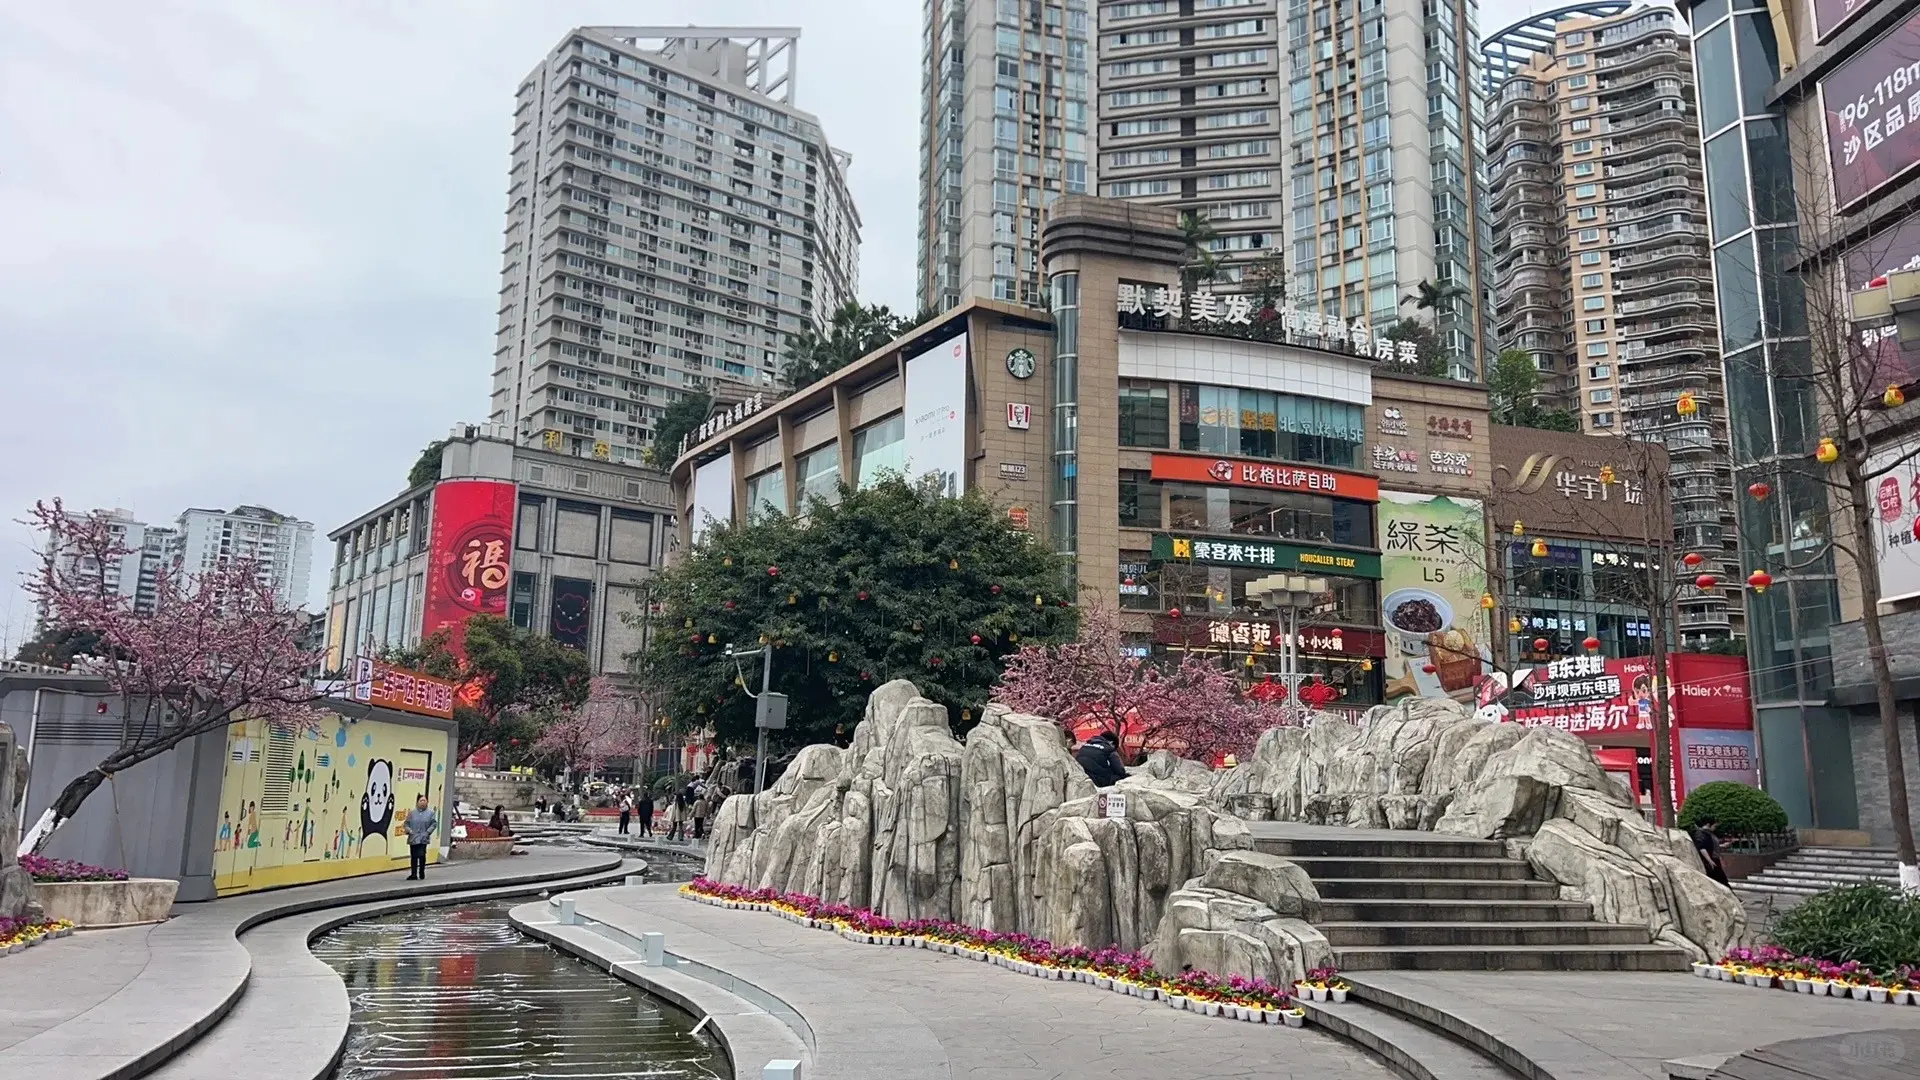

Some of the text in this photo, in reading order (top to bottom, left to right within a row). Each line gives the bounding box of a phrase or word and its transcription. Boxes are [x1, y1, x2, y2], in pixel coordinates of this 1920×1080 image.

[1117, 283, 1252, 325] 默契美发
[1242, 464, 1337, 491] 比格比萨自助
[1556, 471, 1644, 505] 华宇广场
[461, 539, 509, 590] 福
[1336, 557, 1356, 568] STEAK
[1423, 567, 1445, 583] L5
[1209, 620, 1272, 646] 德香苑
[1547, 654, 1605, 679] 京东来啦!
[372, 670, 416, 705] 二手严选
[1533, 678, 1621, 701] 沙坪坝京东电器
[1682, 684, 1711, 697] Haier
